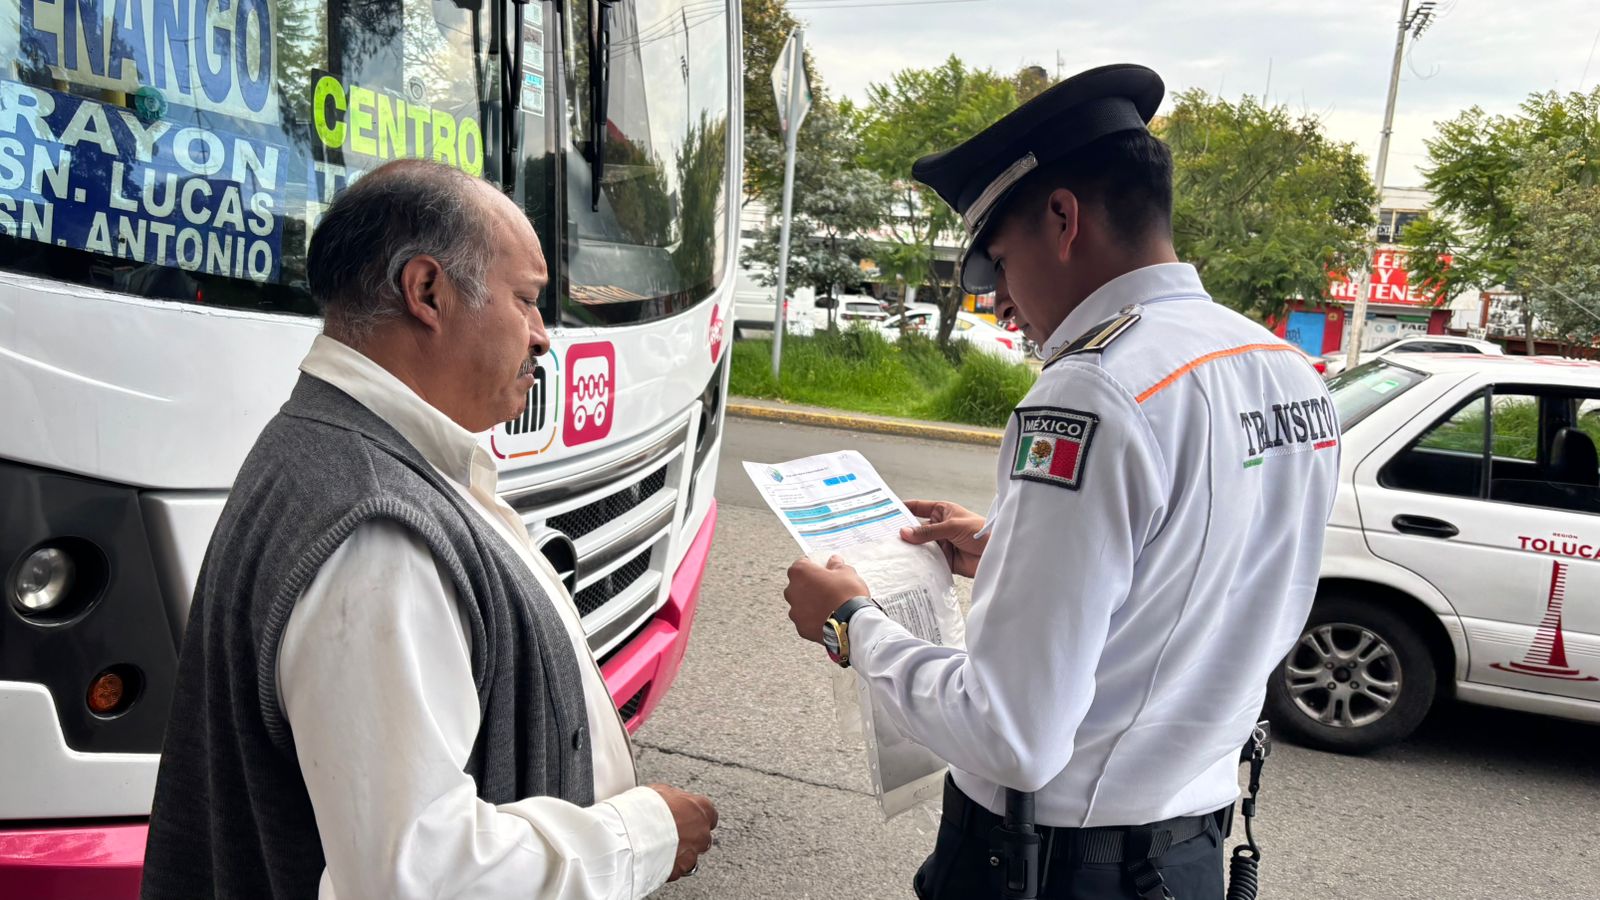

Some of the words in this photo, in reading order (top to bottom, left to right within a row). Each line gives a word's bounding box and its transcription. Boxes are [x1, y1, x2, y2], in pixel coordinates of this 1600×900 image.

[0, 80, 279, 190] RAYON
[313, 75, 484, 177] CENTRO
[0, 137, 87, 203] SN.
[109, 161, 275, 237] LUCAS
[85, 211, 273, 283] ANTONIO
[1377, 268, 1394, 284] Y
[1025, 417, 1081, 436] MÉXICO
